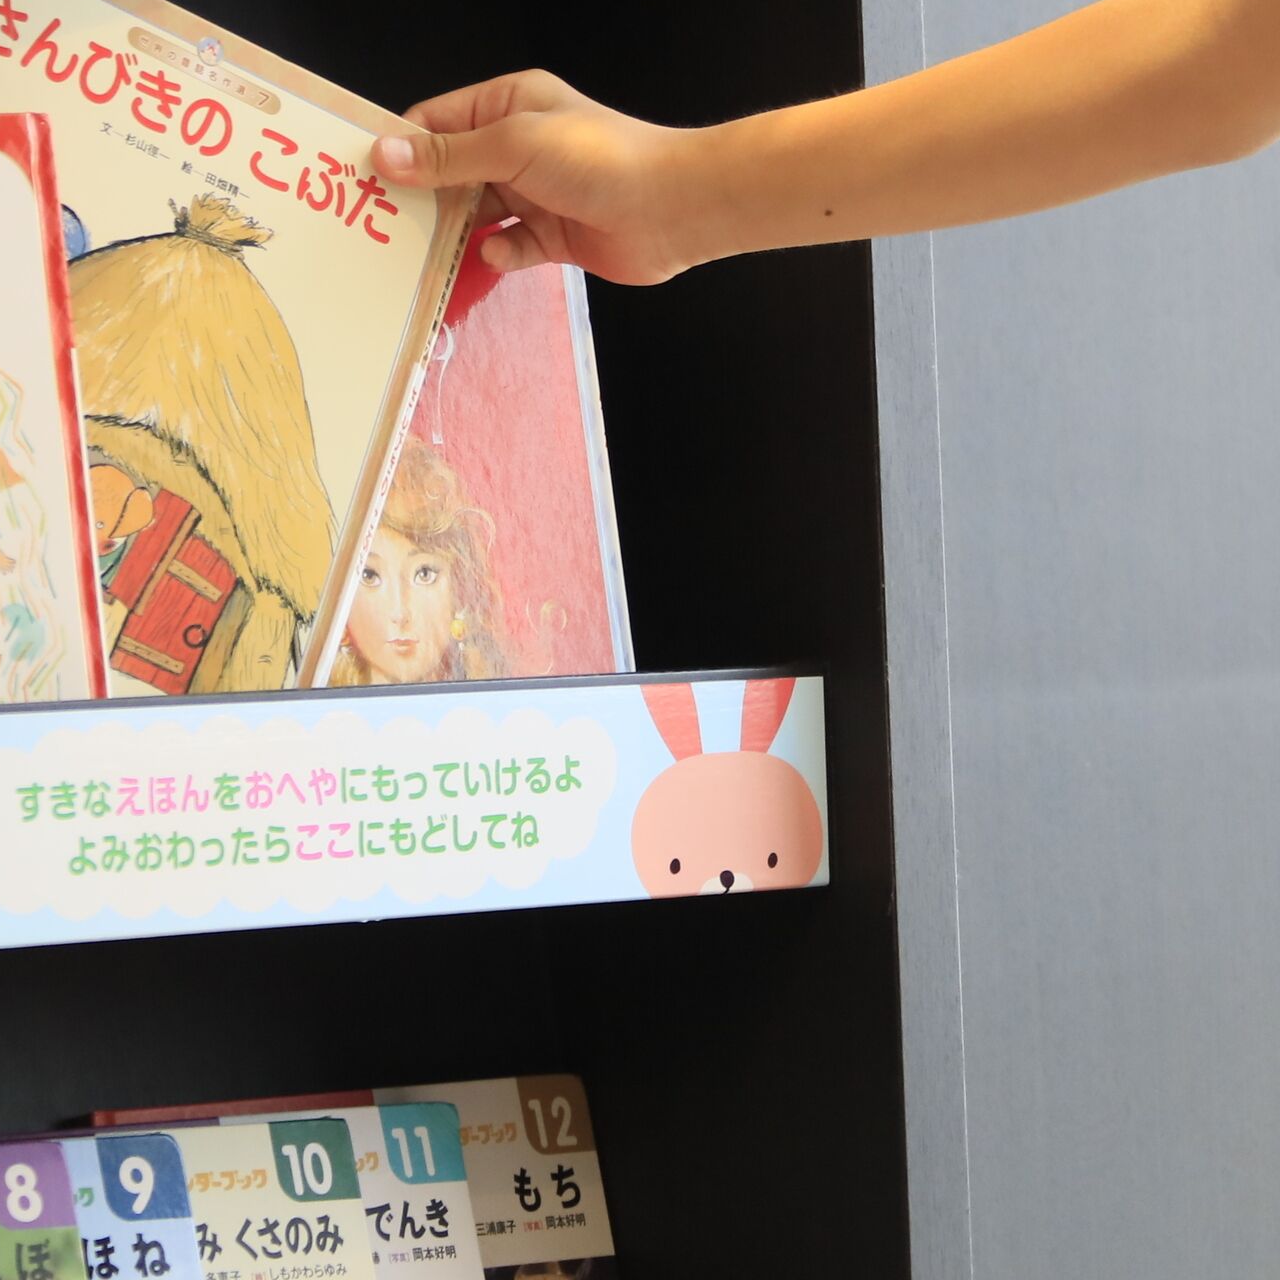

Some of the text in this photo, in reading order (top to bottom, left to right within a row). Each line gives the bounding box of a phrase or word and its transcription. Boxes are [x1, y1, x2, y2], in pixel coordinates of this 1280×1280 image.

[249, 128, 399, 245] こぶた
[15, 753, 583, 823] すきなえほんをおへやにもっていけるよ
[67, 810, 541, 877] よみおわったらここにもどしてね
[527, 1095, 578, 1150] 12
[281, 1141, 333, 1196] 10
[391, 1126, 436, 1178] 11
[4, 1163, 43, 1223] 8
[119, 1155, 155, 1215] 9
[513, 1163, 582, 1213] もち
[195, 1214, 345, 1264] み くさのみ
[364, 1198, 450, 1242] でんき
[545, 1212, 587, 1230] 岡本好明
[80, 1232, 170, 1280] ほね
[269, 1263, 348, 1280] しもかわらゆみ
[412, 1245, 458, 1262] 岡本好明
